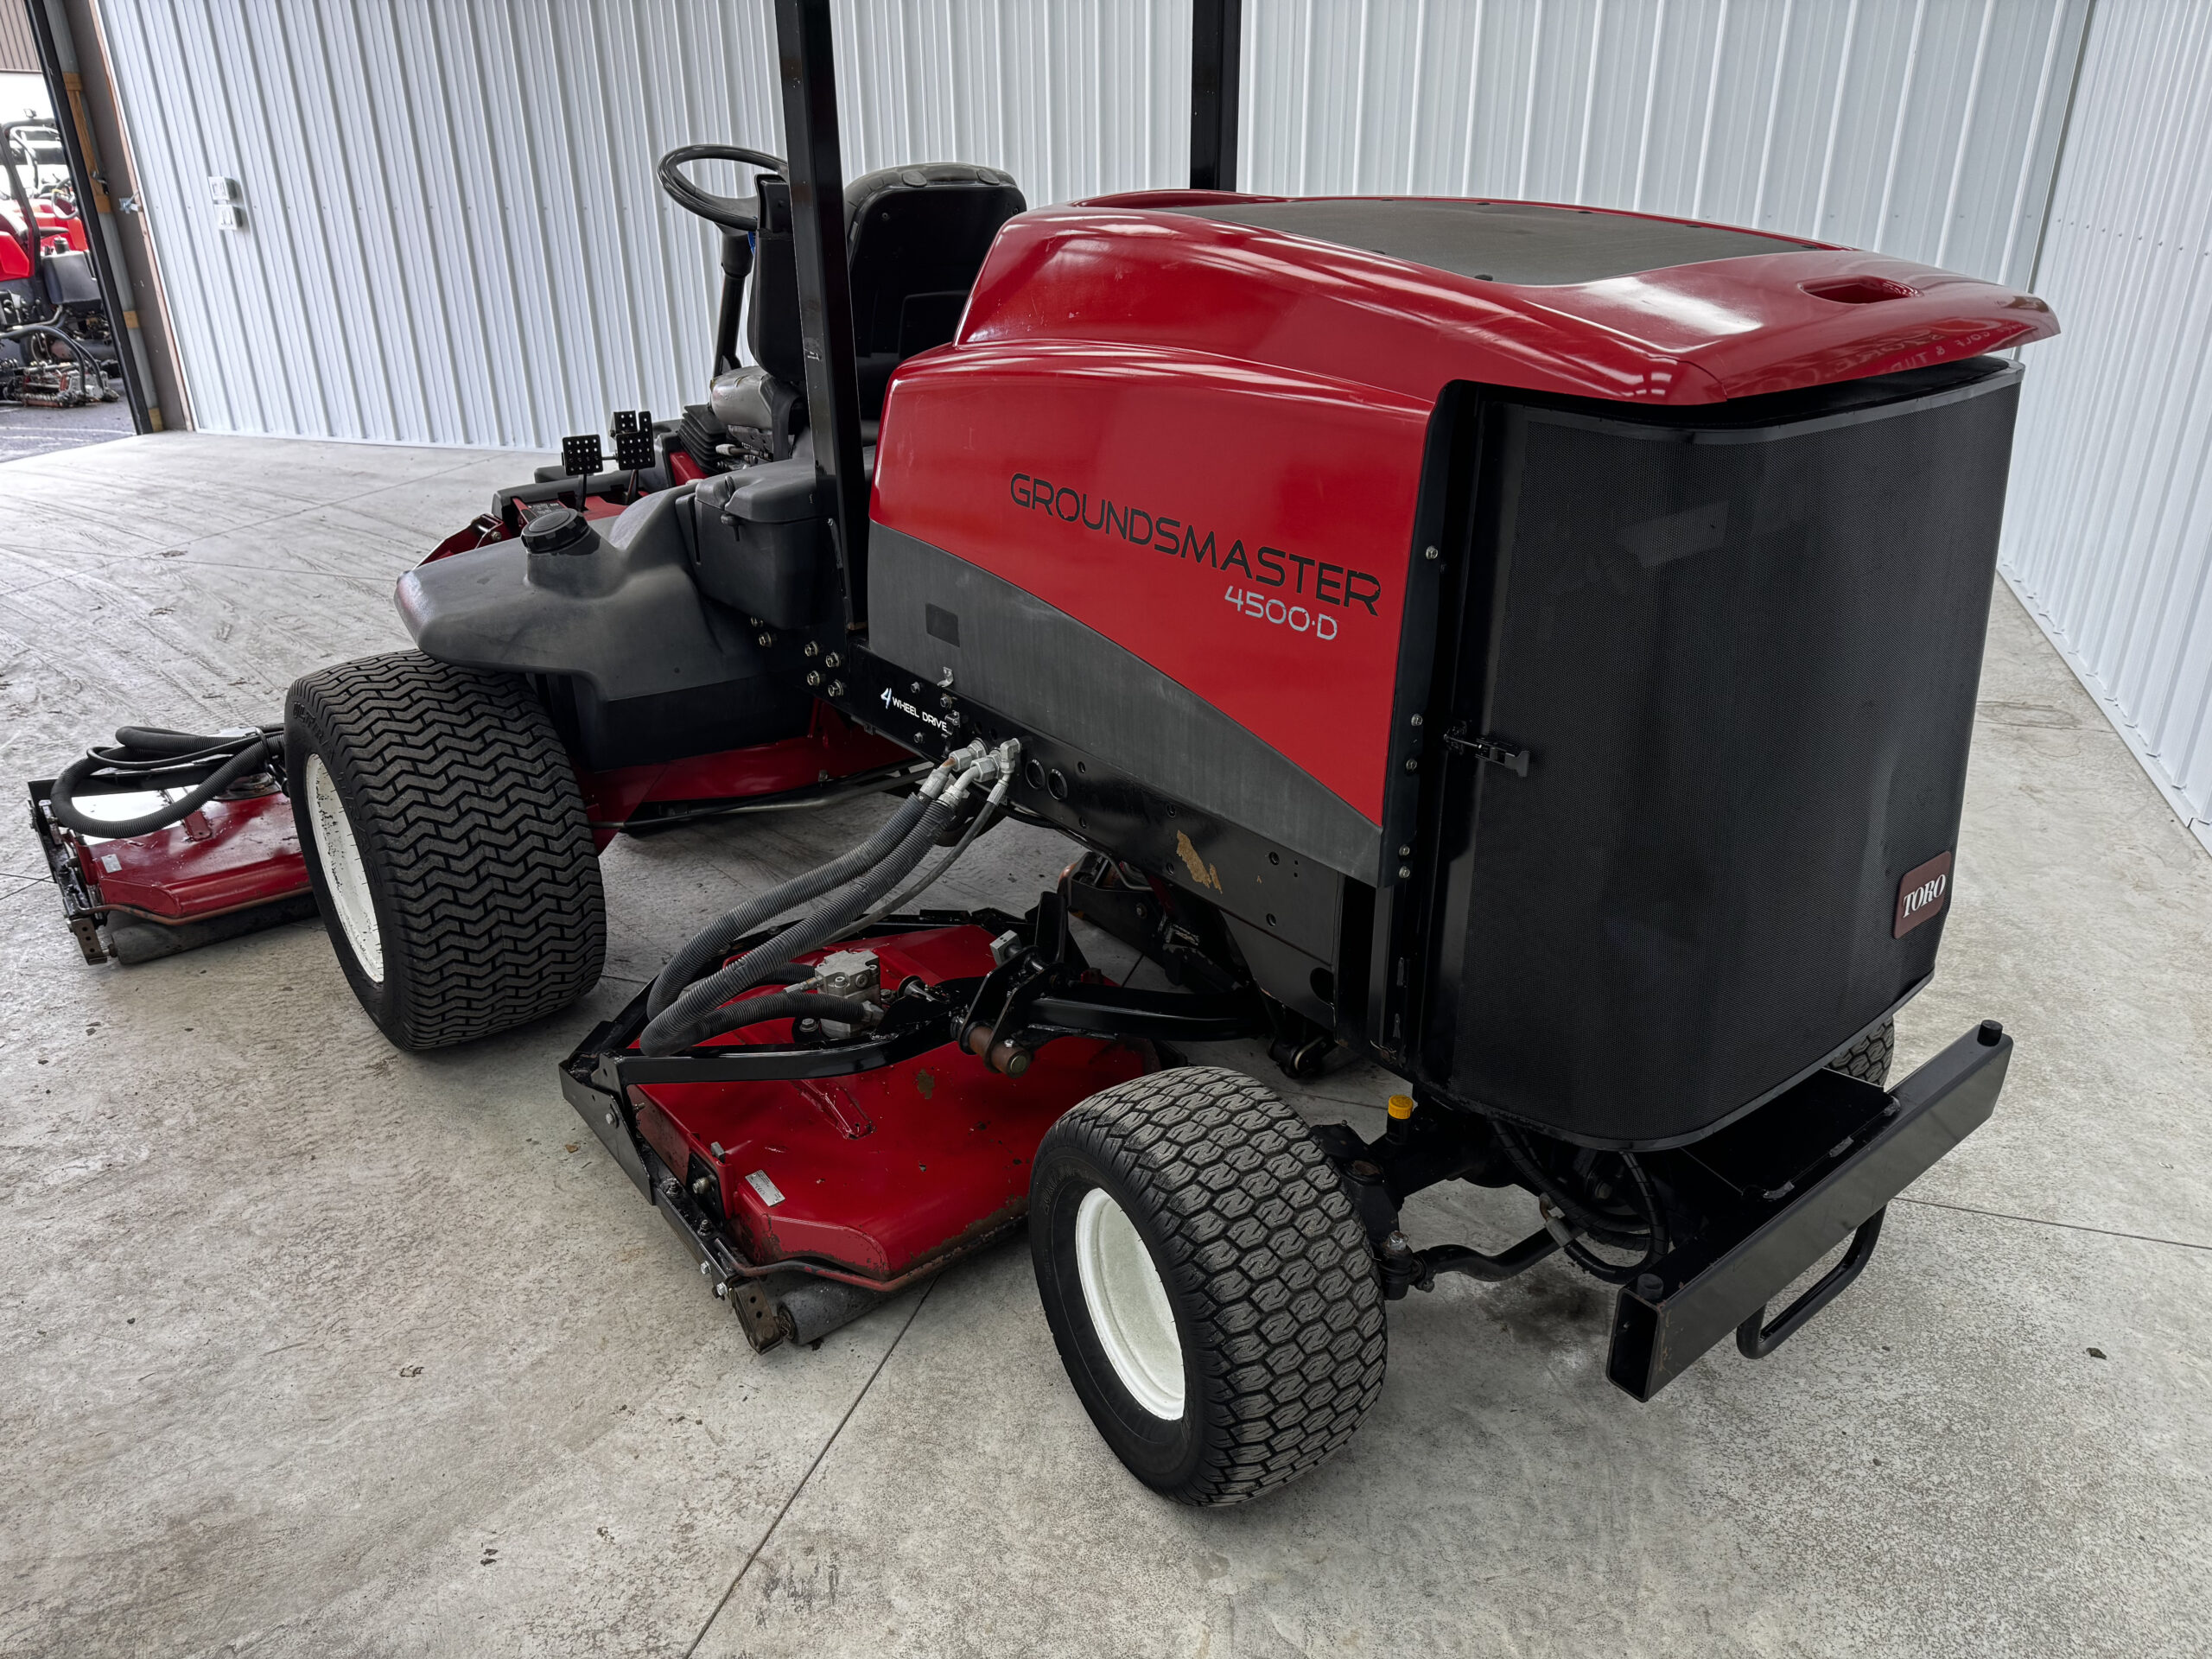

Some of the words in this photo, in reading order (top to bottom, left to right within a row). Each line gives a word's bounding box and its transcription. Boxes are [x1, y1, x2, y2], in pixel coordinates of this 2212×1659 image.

[1010, 473, 1382, 616] GROUNDSMASTER
[880, 687, 892, 709] 4
[892, 696, 920, 719] WHEEL
[922, 710, 948, 733] DRIVE
[1902, 874, 1947, 918] TORO
